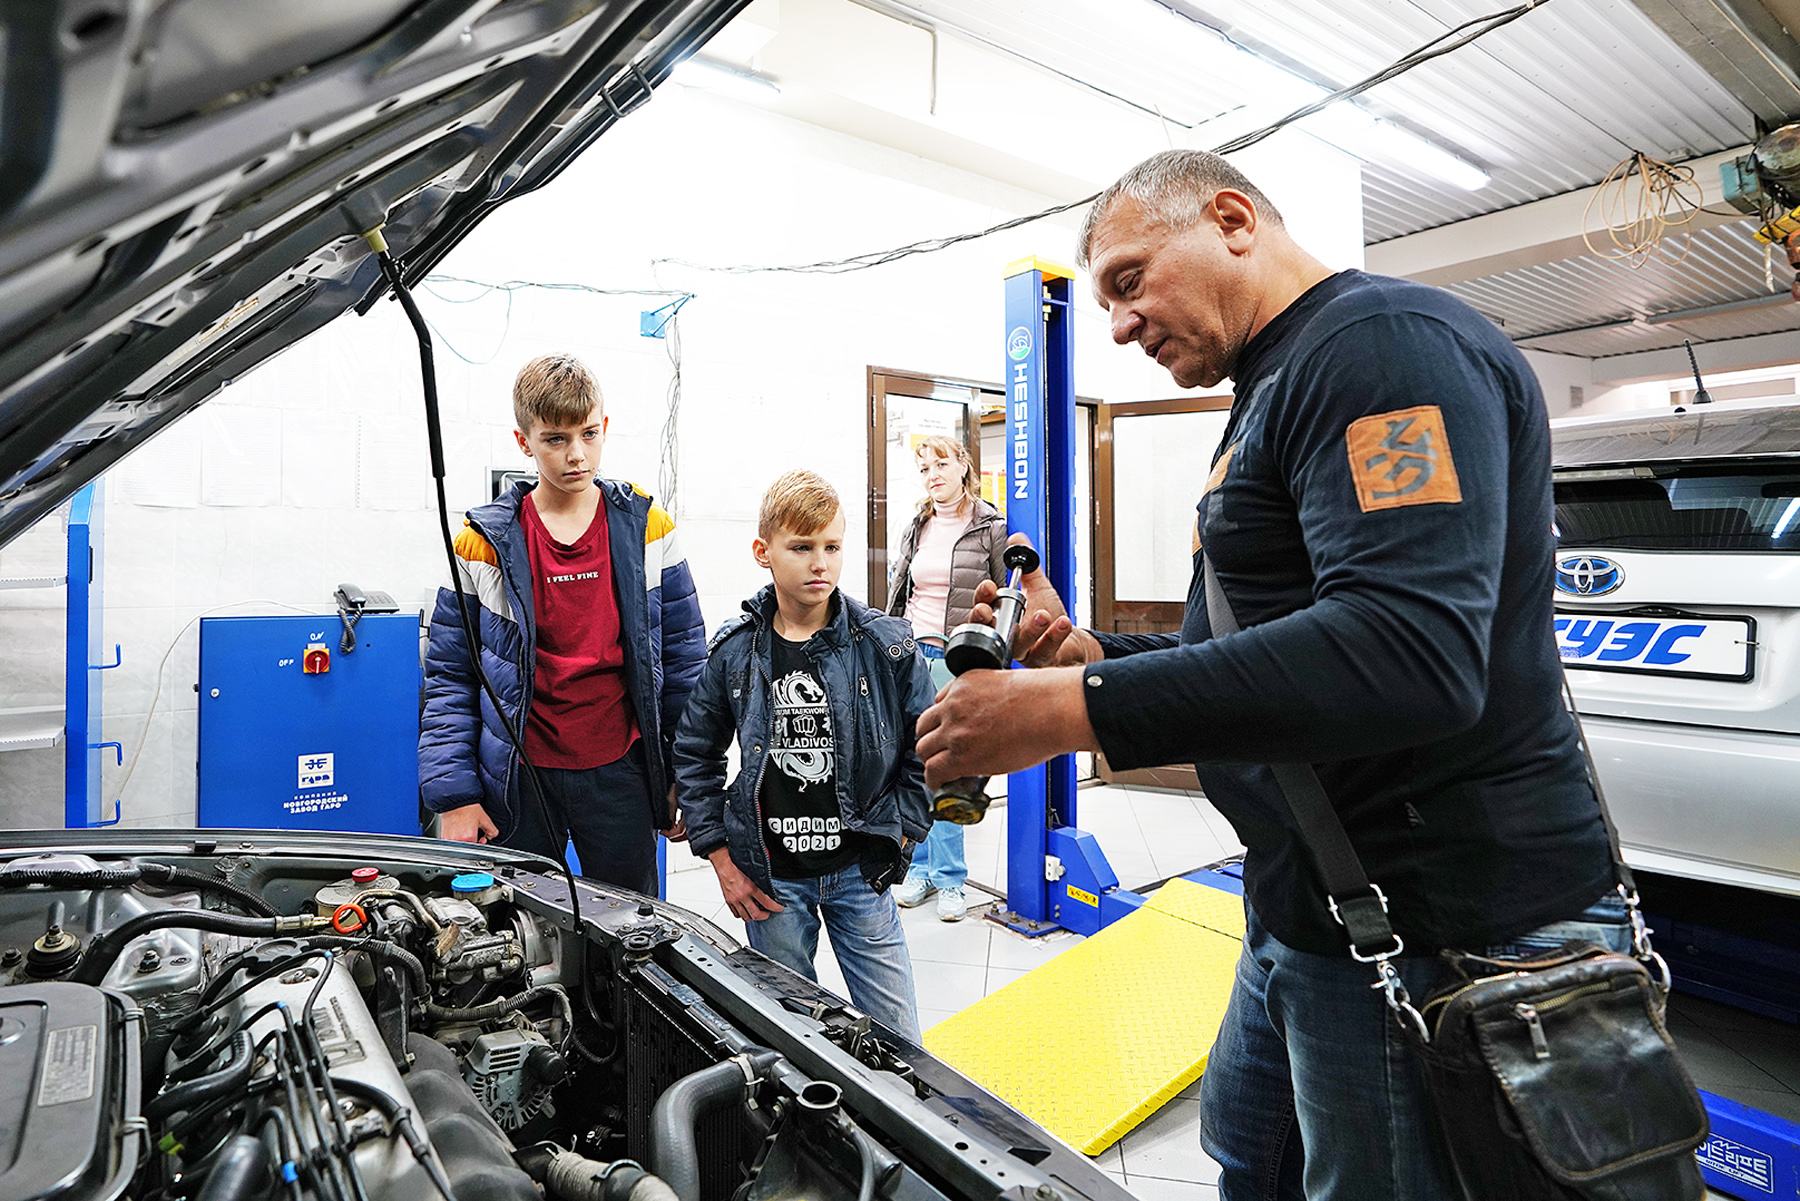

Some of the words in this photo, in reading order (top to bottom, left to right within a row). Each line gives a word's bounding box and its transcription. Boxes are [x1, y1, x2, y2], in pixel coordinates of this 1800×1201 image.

[1014, 362, 1028, 499] HESHBON
[552, 574, 575, 582] FEEL
[577, 571, 599, 580] FINE
[309, 631, 325, 641] ON
[278, 658, 295, 667] OFF
[283, 793, 348, 808] НОВГОРОДСКИЙ
[290, 804, 318, 813] ЗАВОД
[320, 802, 342, 810] ГАРО
[769, 818, 839, 832] СИДИМ
[785, 837, 838, 851] 2021
[1694, 1141, 1768, 1182] 이드리프트
